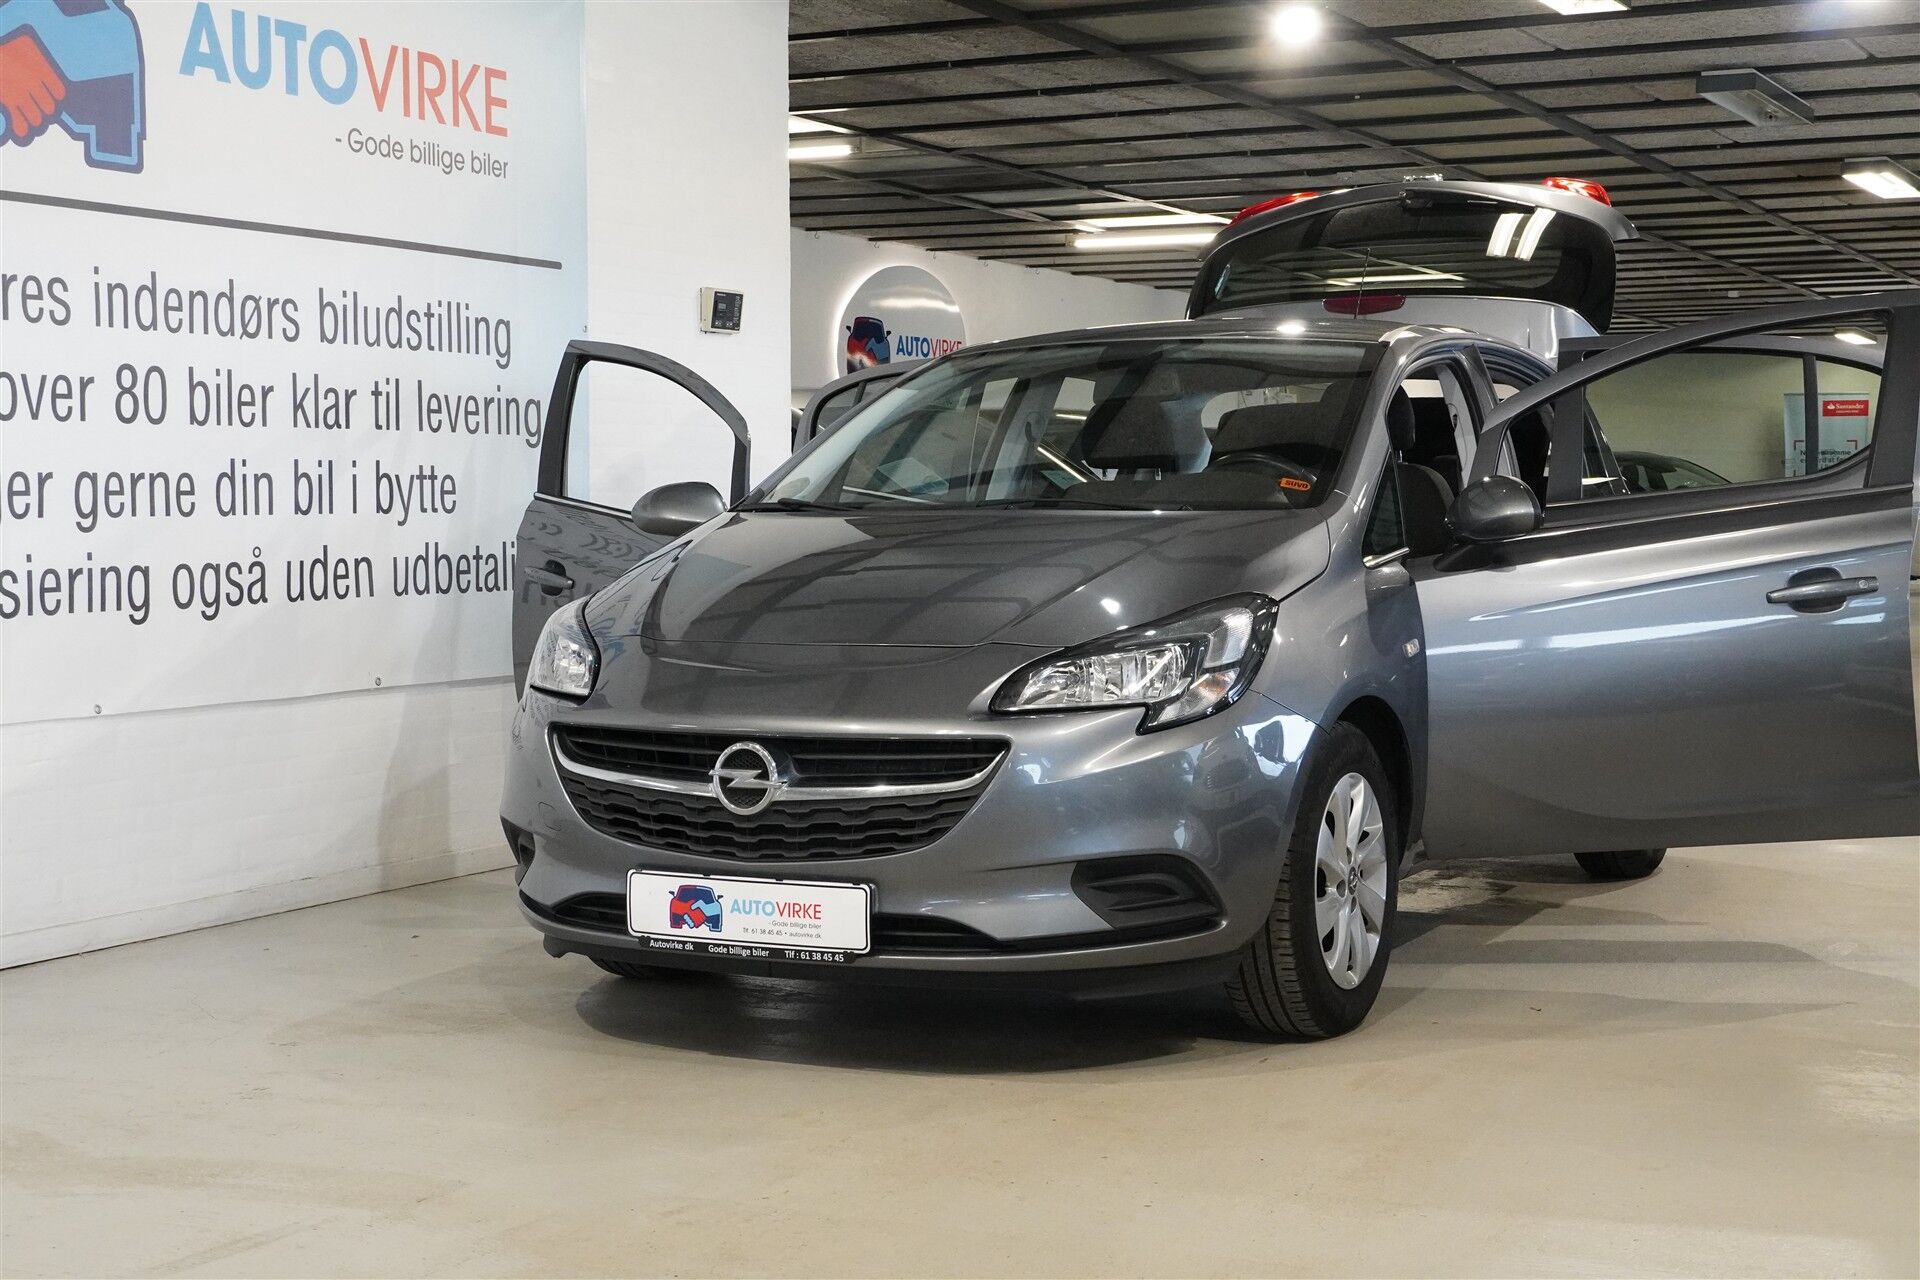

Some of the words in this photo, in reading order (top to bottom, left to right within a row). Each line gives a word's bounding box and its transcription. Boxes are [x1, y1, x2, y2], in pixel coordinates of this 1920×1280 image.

[179, 2, 508, 138] AUTOVIRKE
[347, 127, 404, 160] Gode
[410, 138, 465, 175] billige
[471, 150, 509, 179] biler
[1, 273, 72, 327] res
[93, 265, 300, 343] indendørs
[318, 287, 511, 370] biludstilling
[0, 371, 95, 423] over
[115, 363, 168, 425] 80
[188, 366, 274, 428] biler
[292, 372, 357, 430] klar
[371, 378, 401, 431] til
[417, 379, 542, 449] levering
[0, 466, 54, 528] er
[74, 470, 196, 533] gerne
[215, 458, 274, 517] din
[293, 458, 334, 515] bil
[352, 459, 358, 514] i
[375, 459, 457, 526] bytte
[172, 546, 269, 621] også
[286, 544, 375, 602] uden
[730, 898, 821, 920] AUTOVIRKE
[790, 921, 807, 930] billige
[649, 939, 683, 950] Autovirke
[708, 944, 727, 953] Gode
[729, 947, 750, 956] billige
[752, 948, 769, 957] biler
[800, 951, 810, 960] 61
[812, 952, 821, 961] 38
[823, 953, 832, 961] 45
[834, 954, 844, 962] 45
